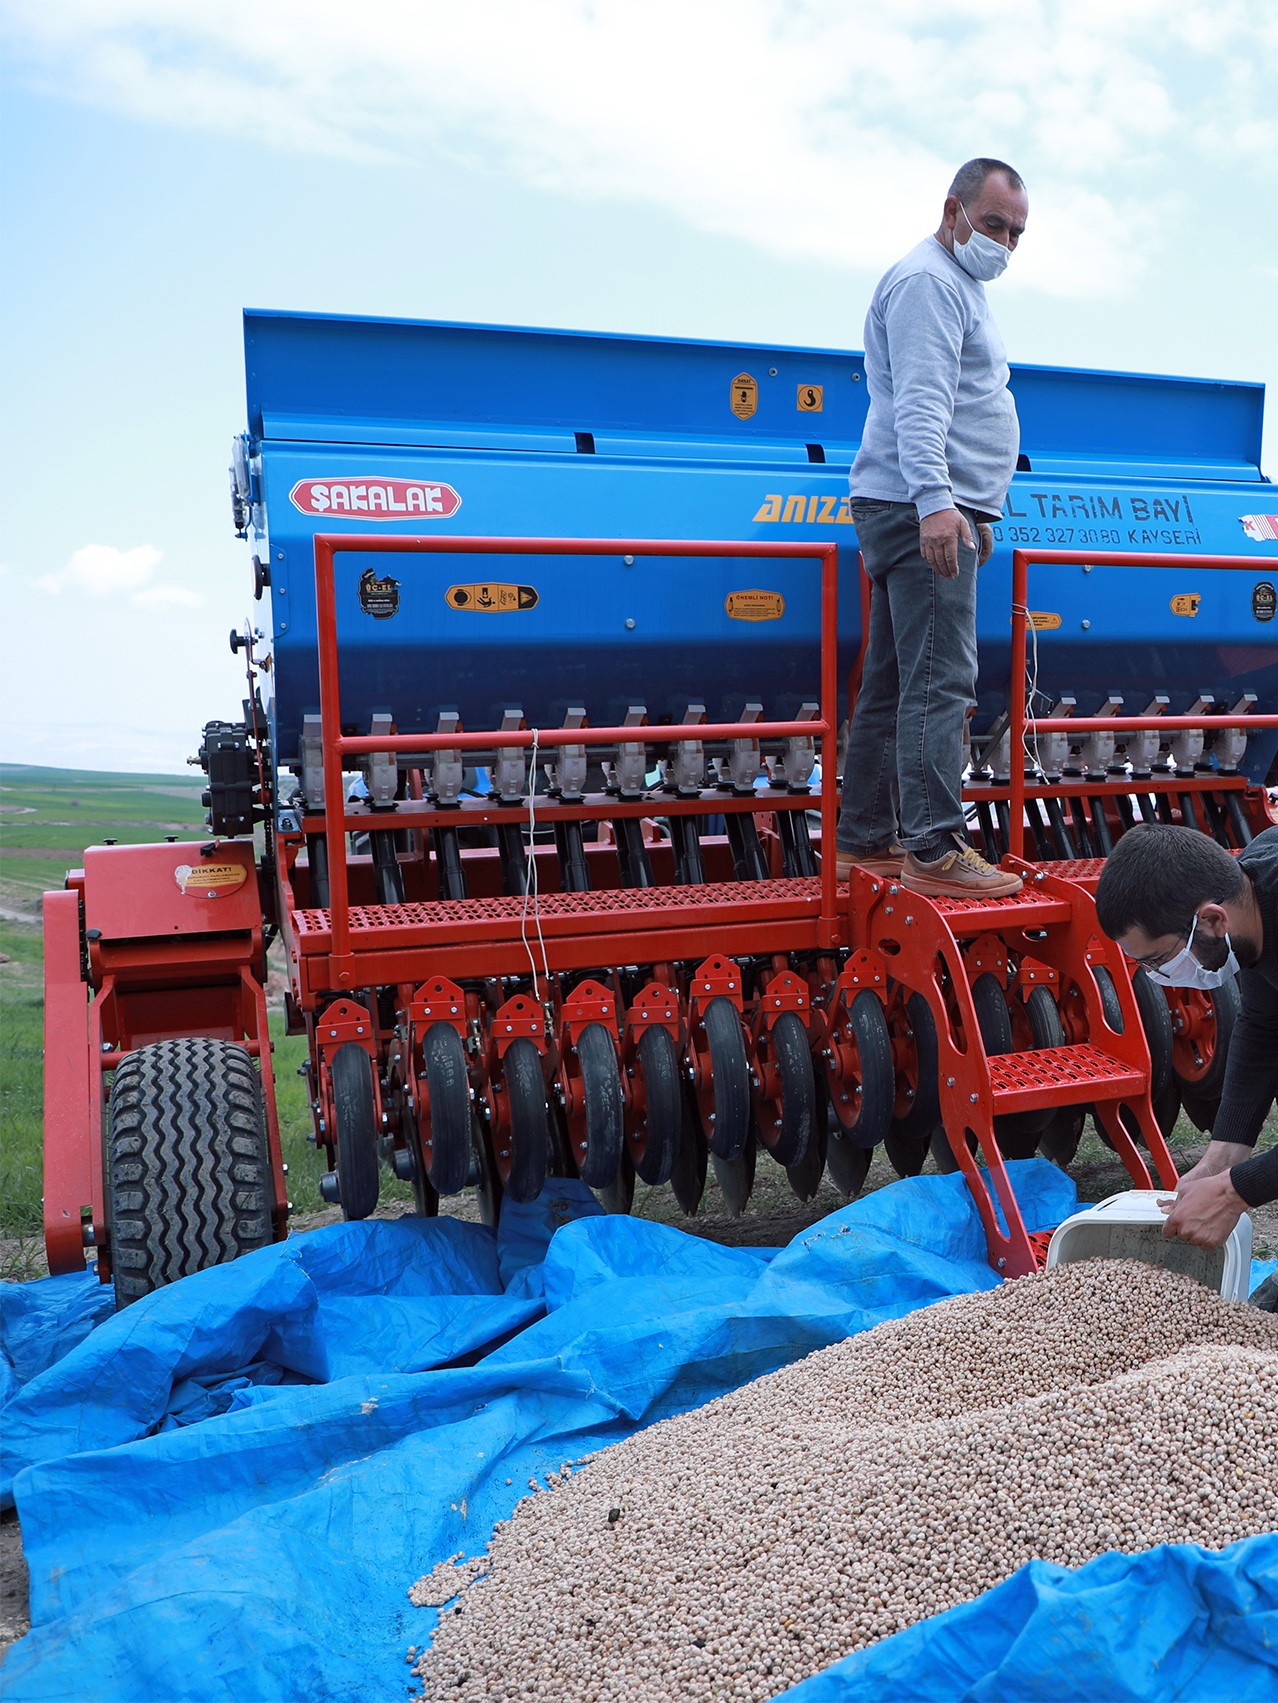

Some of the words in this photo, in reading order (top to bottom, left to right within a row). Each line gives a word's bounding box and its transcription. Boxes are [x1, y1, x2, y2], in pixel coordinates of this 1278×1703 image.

[310, 484, 444, 512] ŞAKALAK
[1030, 493, 1123, 520] TARIM
[1009, 526, 1041, 543] 352
[1045, 527, 1074, 543] 327
